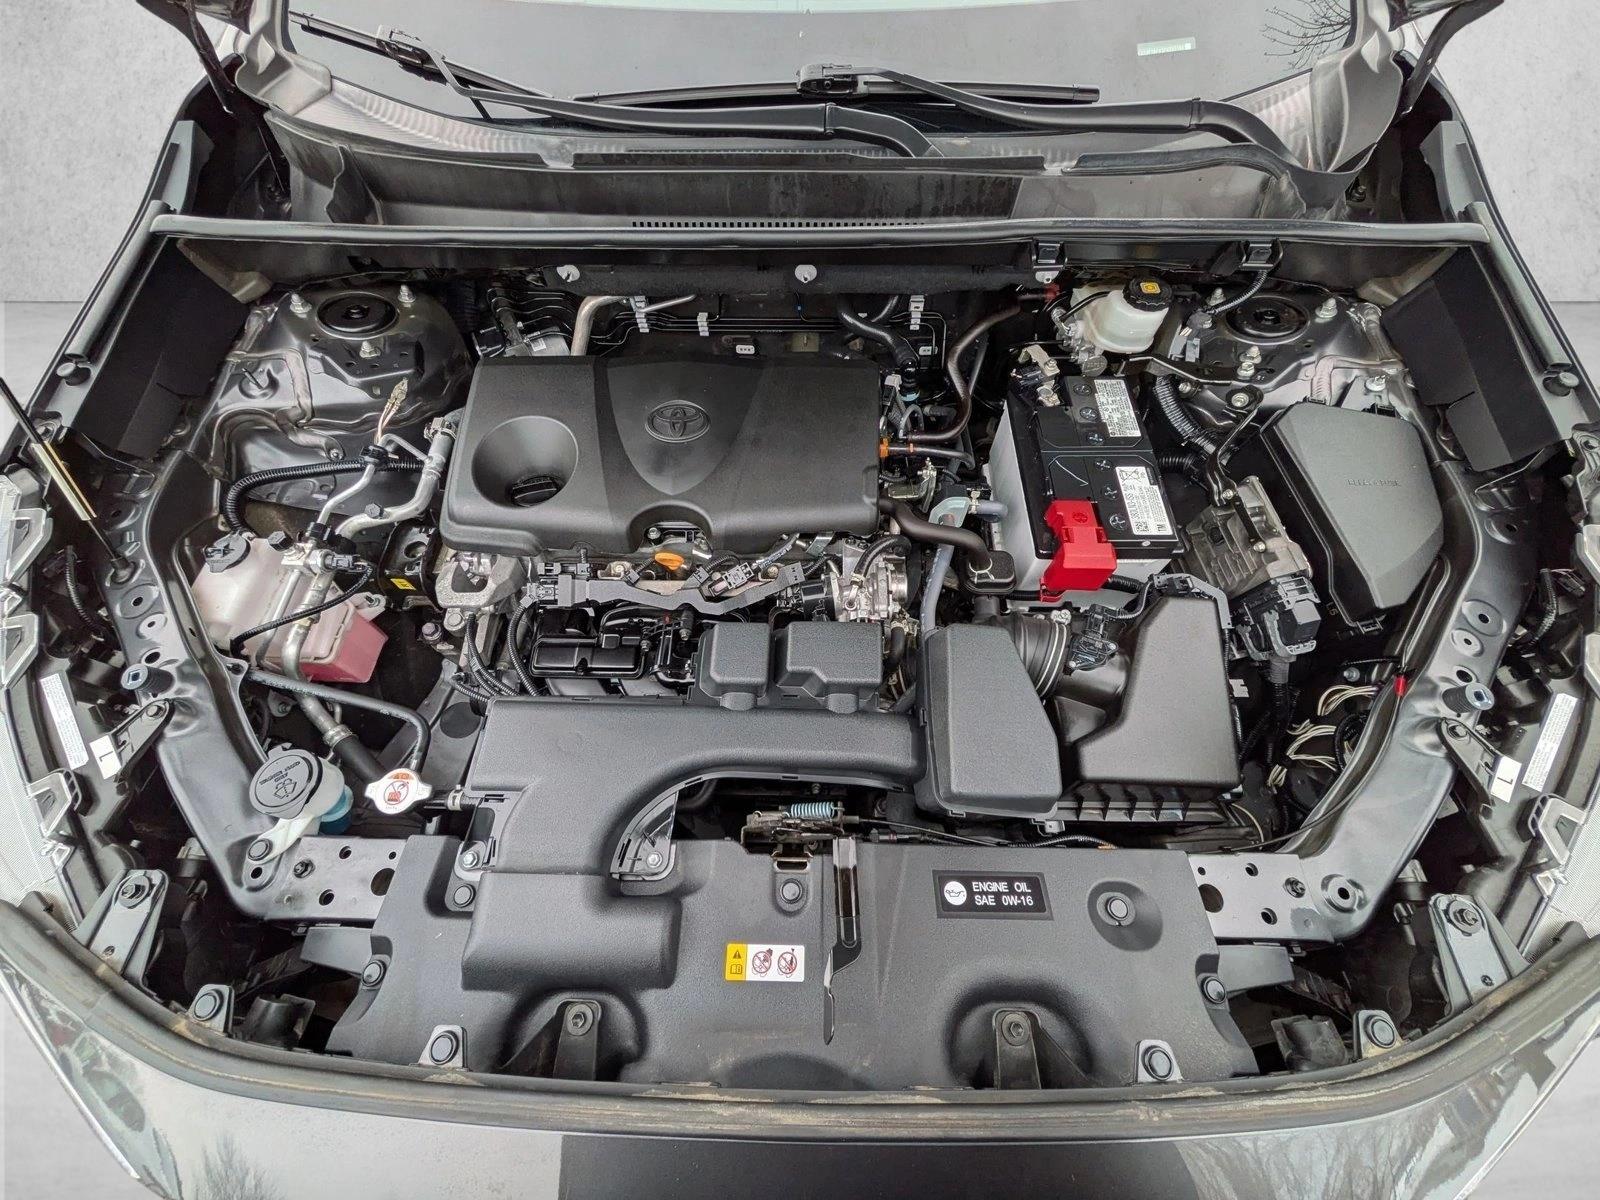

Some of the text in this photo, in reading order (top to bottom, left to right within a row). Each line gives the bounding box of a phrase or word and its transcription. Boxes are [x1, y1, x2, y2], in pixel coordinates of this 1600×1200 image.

[98, 750, 114, 763] L
[1496, 776, 1514, 785] L
[972, 881, 1032, 893] ENGINE OIL
[974, 895, 1034, 906] SAE 0W-16
